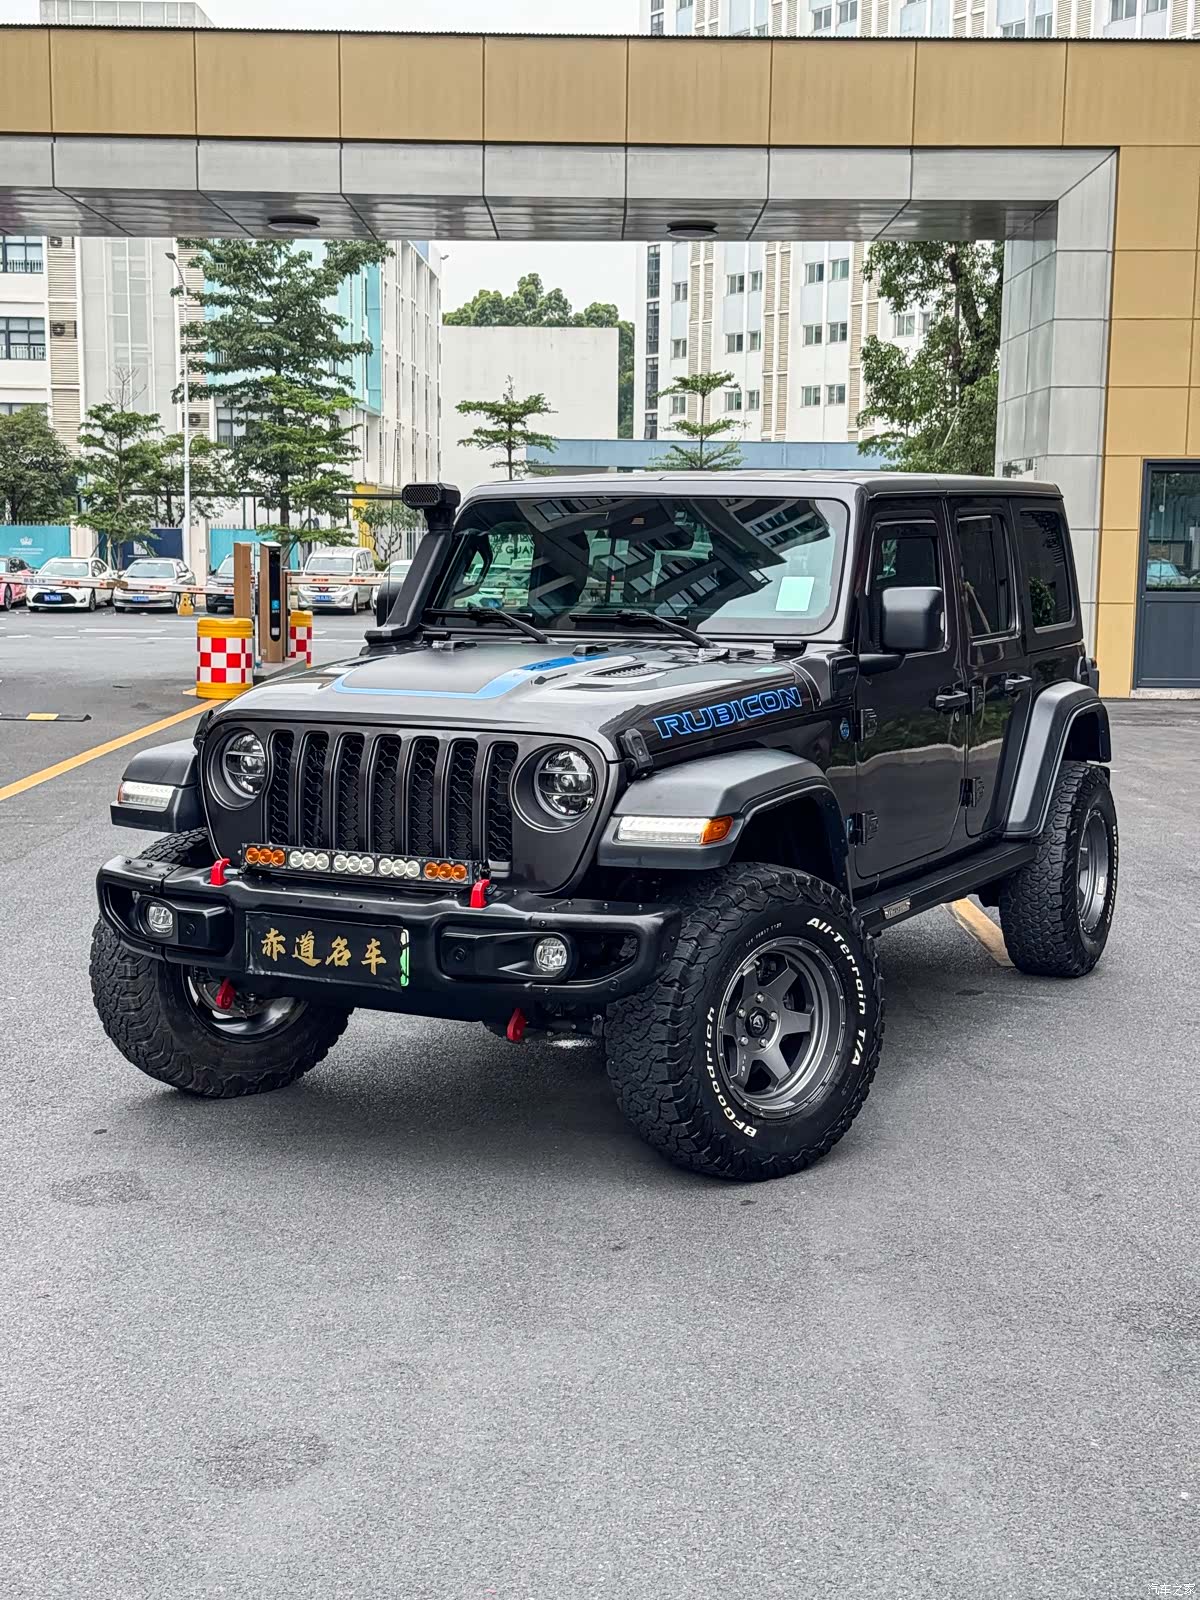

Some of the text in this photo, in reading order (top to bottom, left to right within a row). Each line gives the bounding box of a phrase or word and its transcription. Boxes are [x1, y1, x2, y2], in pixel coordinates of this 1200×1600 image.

[653, 687, 802, 739] RUBICON
[261, 928, 387, 976] 赤道名车
[806, 917, 867, 1066] All-Terrain T/A
[704, 1006, 758, 1138] BFGoodrich
